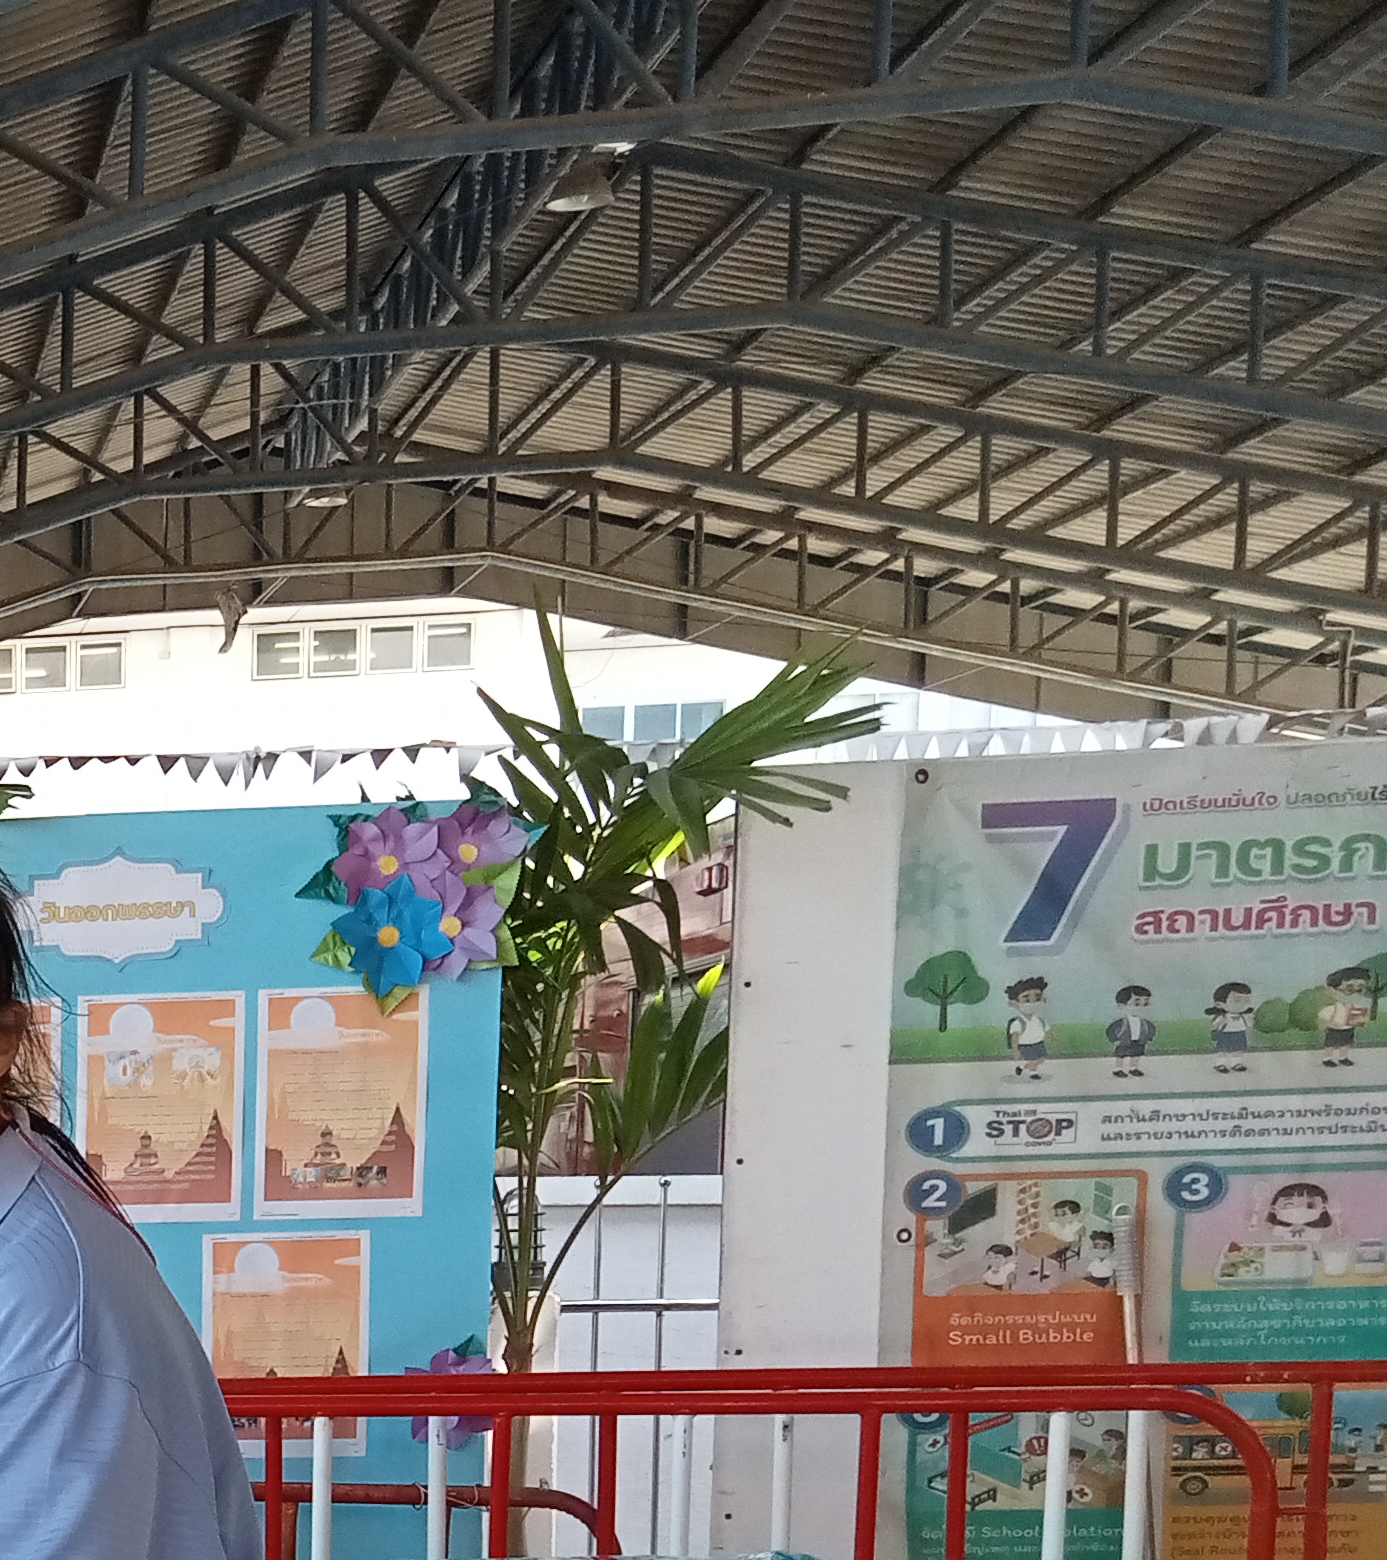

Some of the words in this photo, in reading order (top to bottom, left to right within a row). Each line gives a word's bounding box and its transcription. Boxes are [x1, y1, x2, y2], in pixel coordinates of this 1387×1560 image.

[1142, 789, 1277, 812] เปิดเรียนมั่นใจ
[980, 798, 1117, 944] 7
[39, 900, 197, 925] วันออกพรรษา
[1133, 896, 1377, 936] สถานศึกษา
[994, 1110, 1021, 1118] Thai
[927, 1117, 945, 1146] 1
[985, 1117, 1075, 1139] STOP
[921, 1179, 948, 1208] 2
[1180, 1172, 1211, 1201] 3
[948, 1310, 1097, 1334] จัดกิจกรรมรูปแบบ
[948, 1327, 1012, 1345] Small
[1019, 1327, 1095, 1344] Bubble
[981, 1525, 1041, 1538] School
